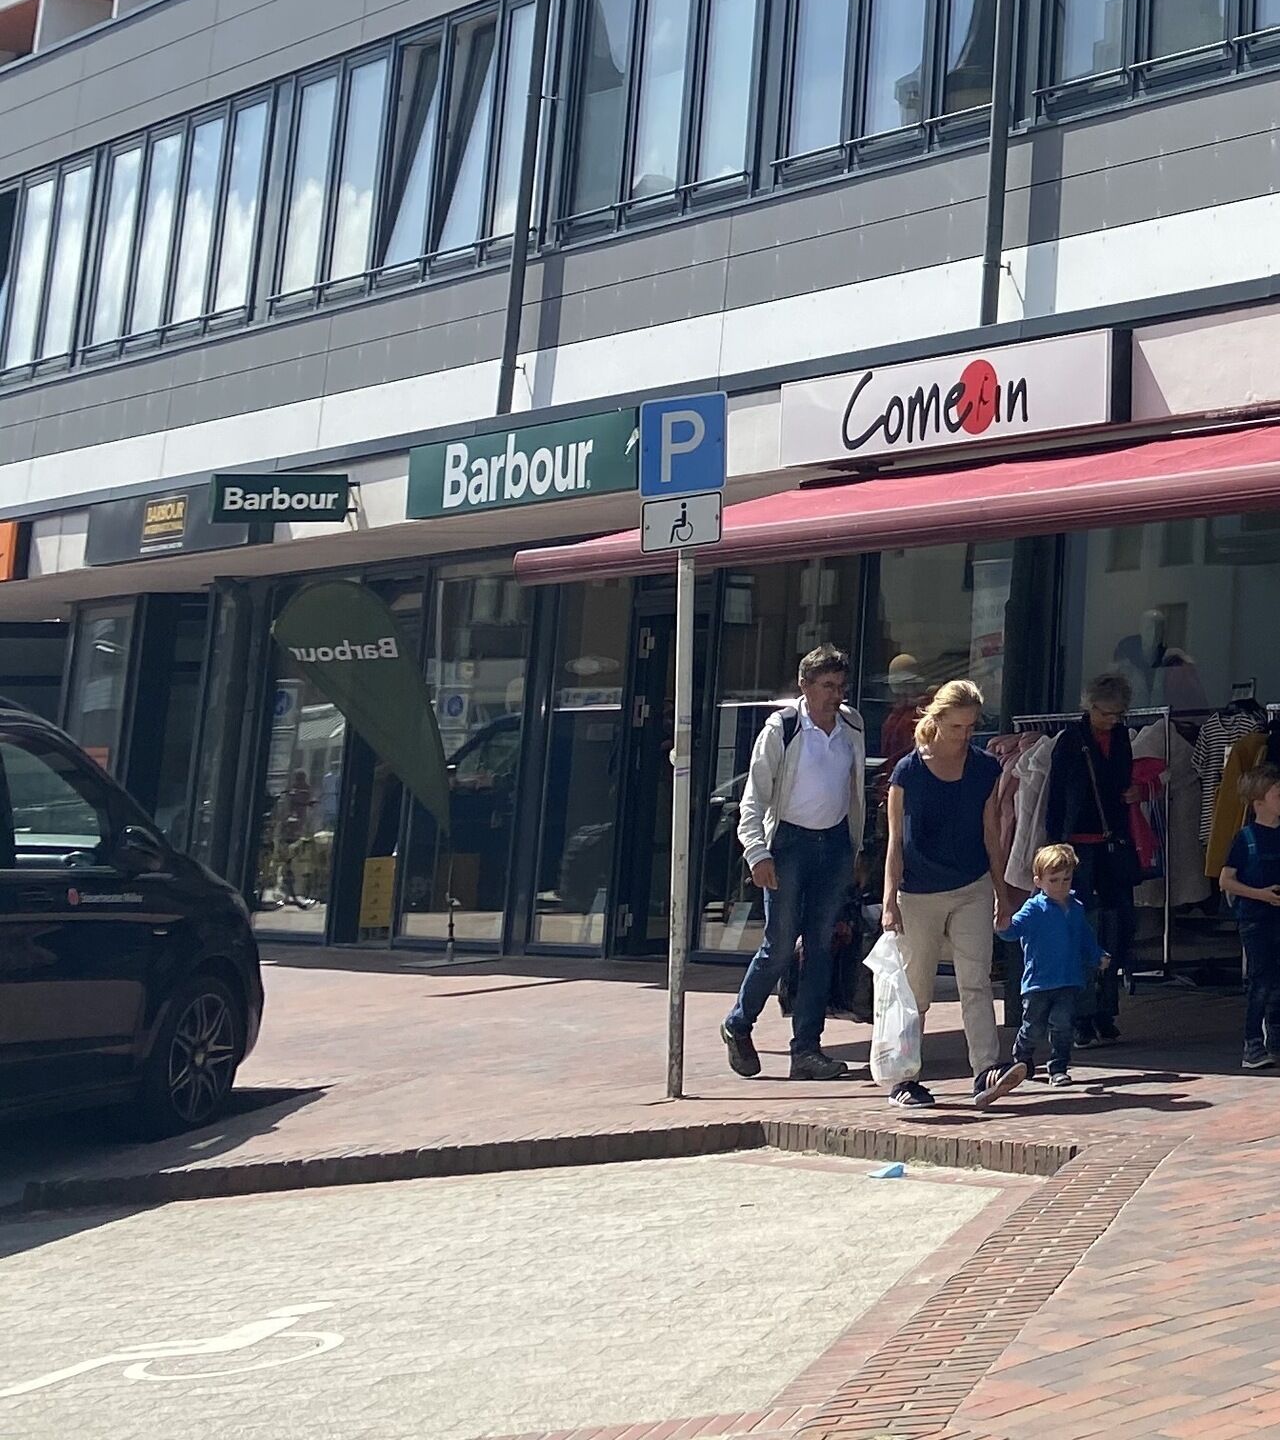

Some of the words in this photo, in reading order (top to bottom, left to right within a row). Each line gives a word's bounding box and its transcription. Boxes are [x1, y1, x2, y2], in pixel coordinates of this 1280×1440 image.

[660, 409, 706, 483] P
[842, 371, 973, 450] Come
[223, 487, 339, 510] Barbour
[442, 433, 594, 509] Barbour
